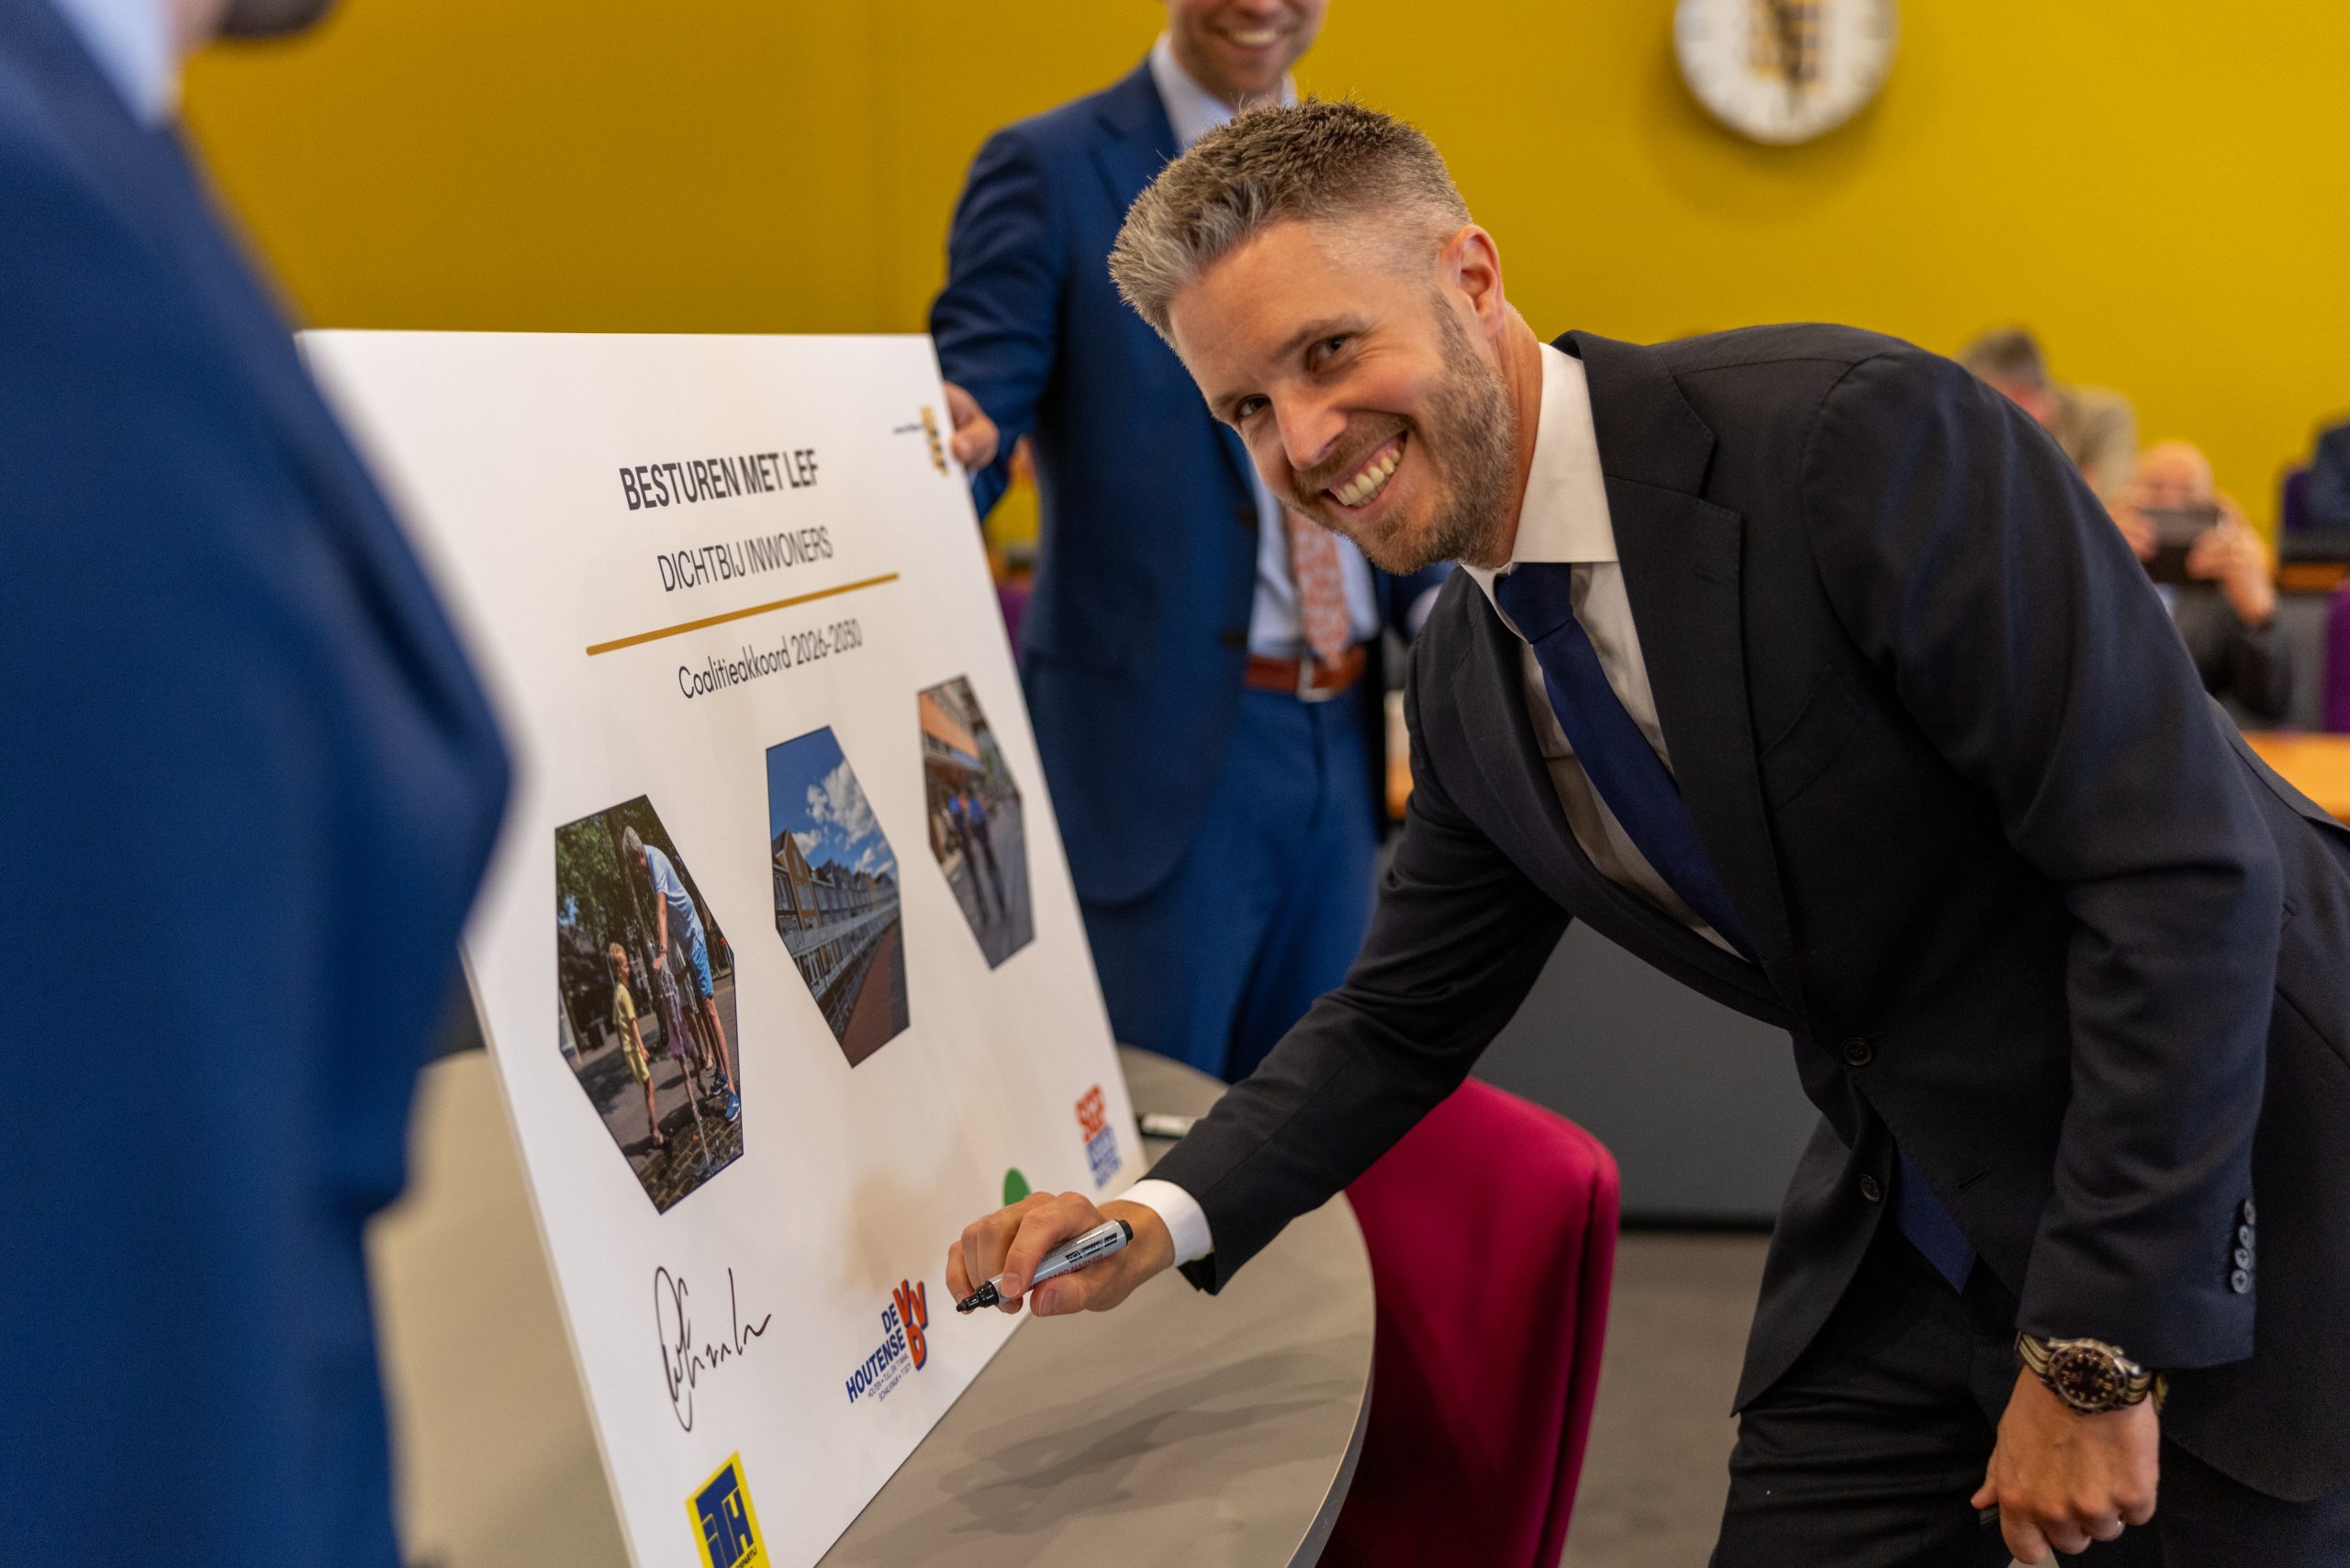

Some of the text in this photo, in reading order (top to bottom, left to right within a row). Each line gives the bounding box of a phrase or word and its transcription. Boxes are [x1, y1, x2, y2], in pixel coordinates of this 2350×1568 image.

[619, 448, 819, 511] BESTUREN MET LEF
[656, 525, 834, 592] DICHTBIJ INWONERS
[678, 617, 864, 699] Coalitieakkoord 2026-2030
[881, 1302, 900, 1334] DE
[845, 1327, 906, 1404] HOUTENSE
